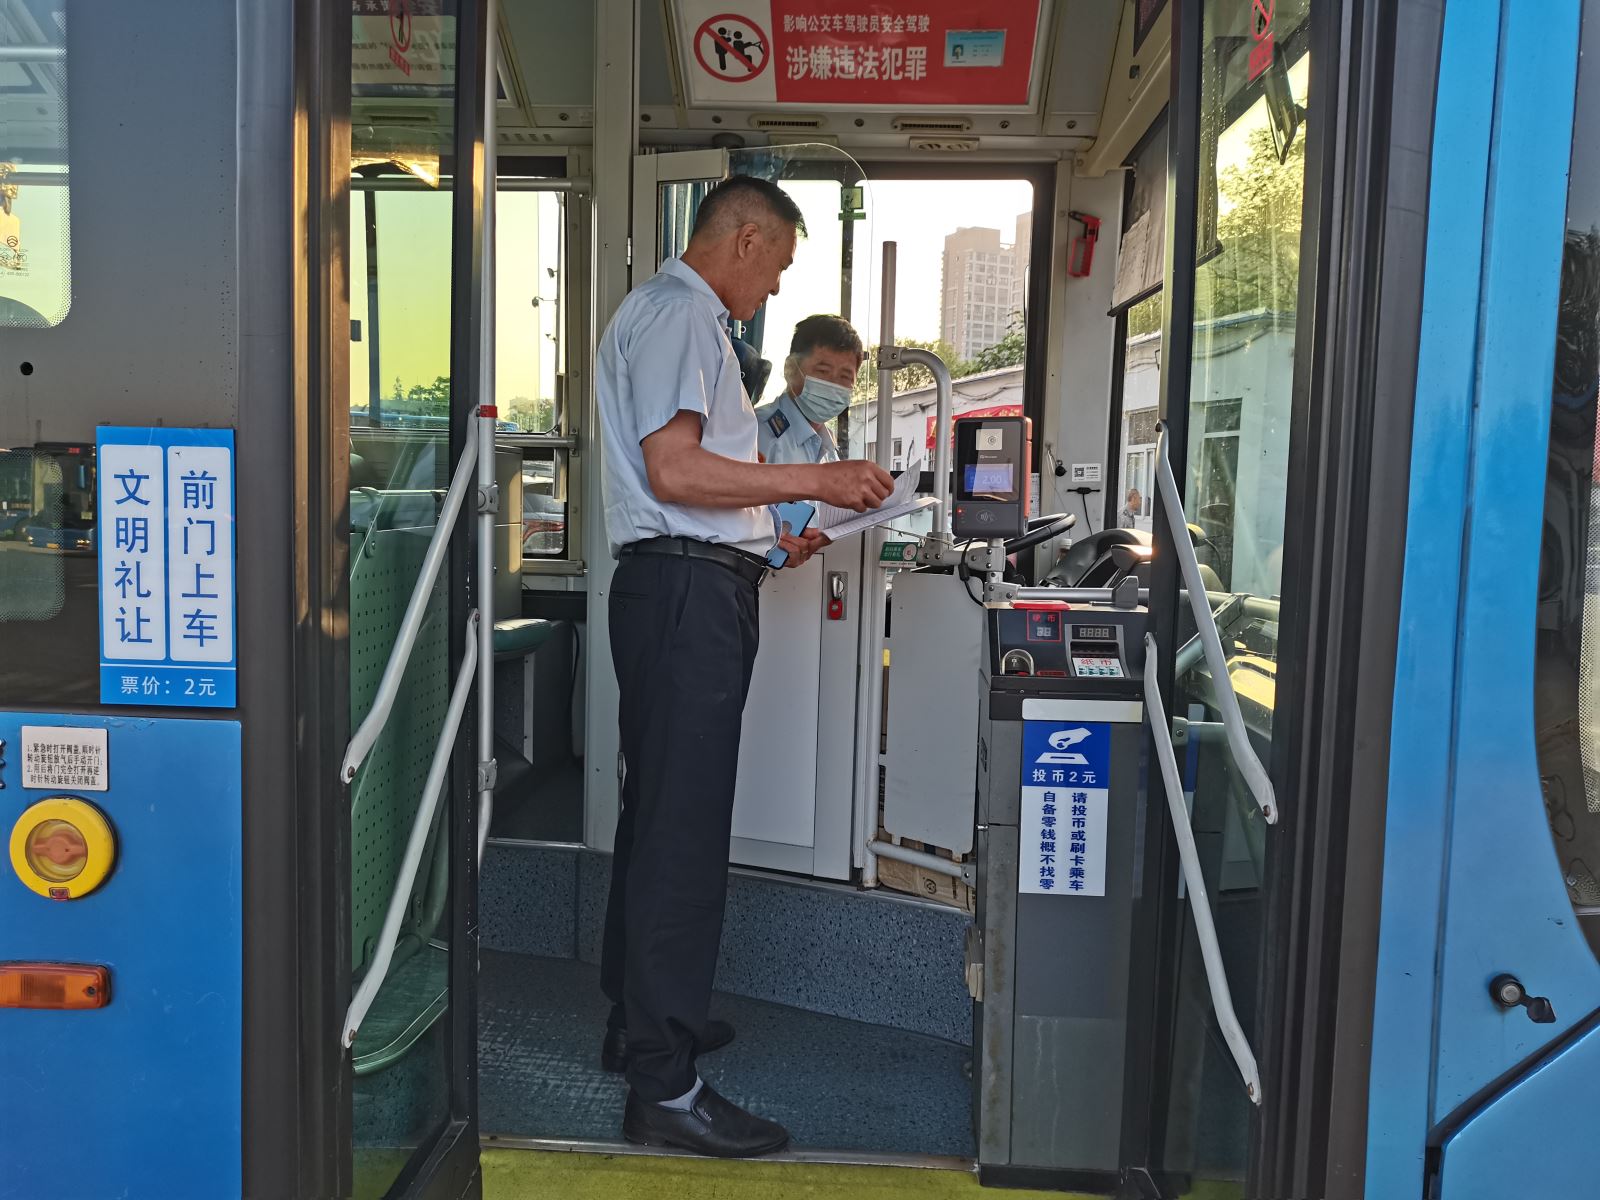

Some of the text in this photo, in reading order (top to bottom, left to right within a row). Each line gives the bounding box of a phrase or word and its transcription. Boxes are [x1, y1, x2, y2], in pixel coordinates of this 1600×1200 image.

[783, 14, 930, 33] 影响公交车驾驶员安全驾驶
[786, 46, 927, 80] 涉嫌违法犯罪
[113, 468, 153, 643] 文明礼让
[180, 470, 218, 648] 前门上车
[1032, 769, 1096, 784] 投币2元
[1039, 791, 1057, 890] 自备零钱概不找零
[1069, 792, 1088, 892] 请投币或刷卡乘车
